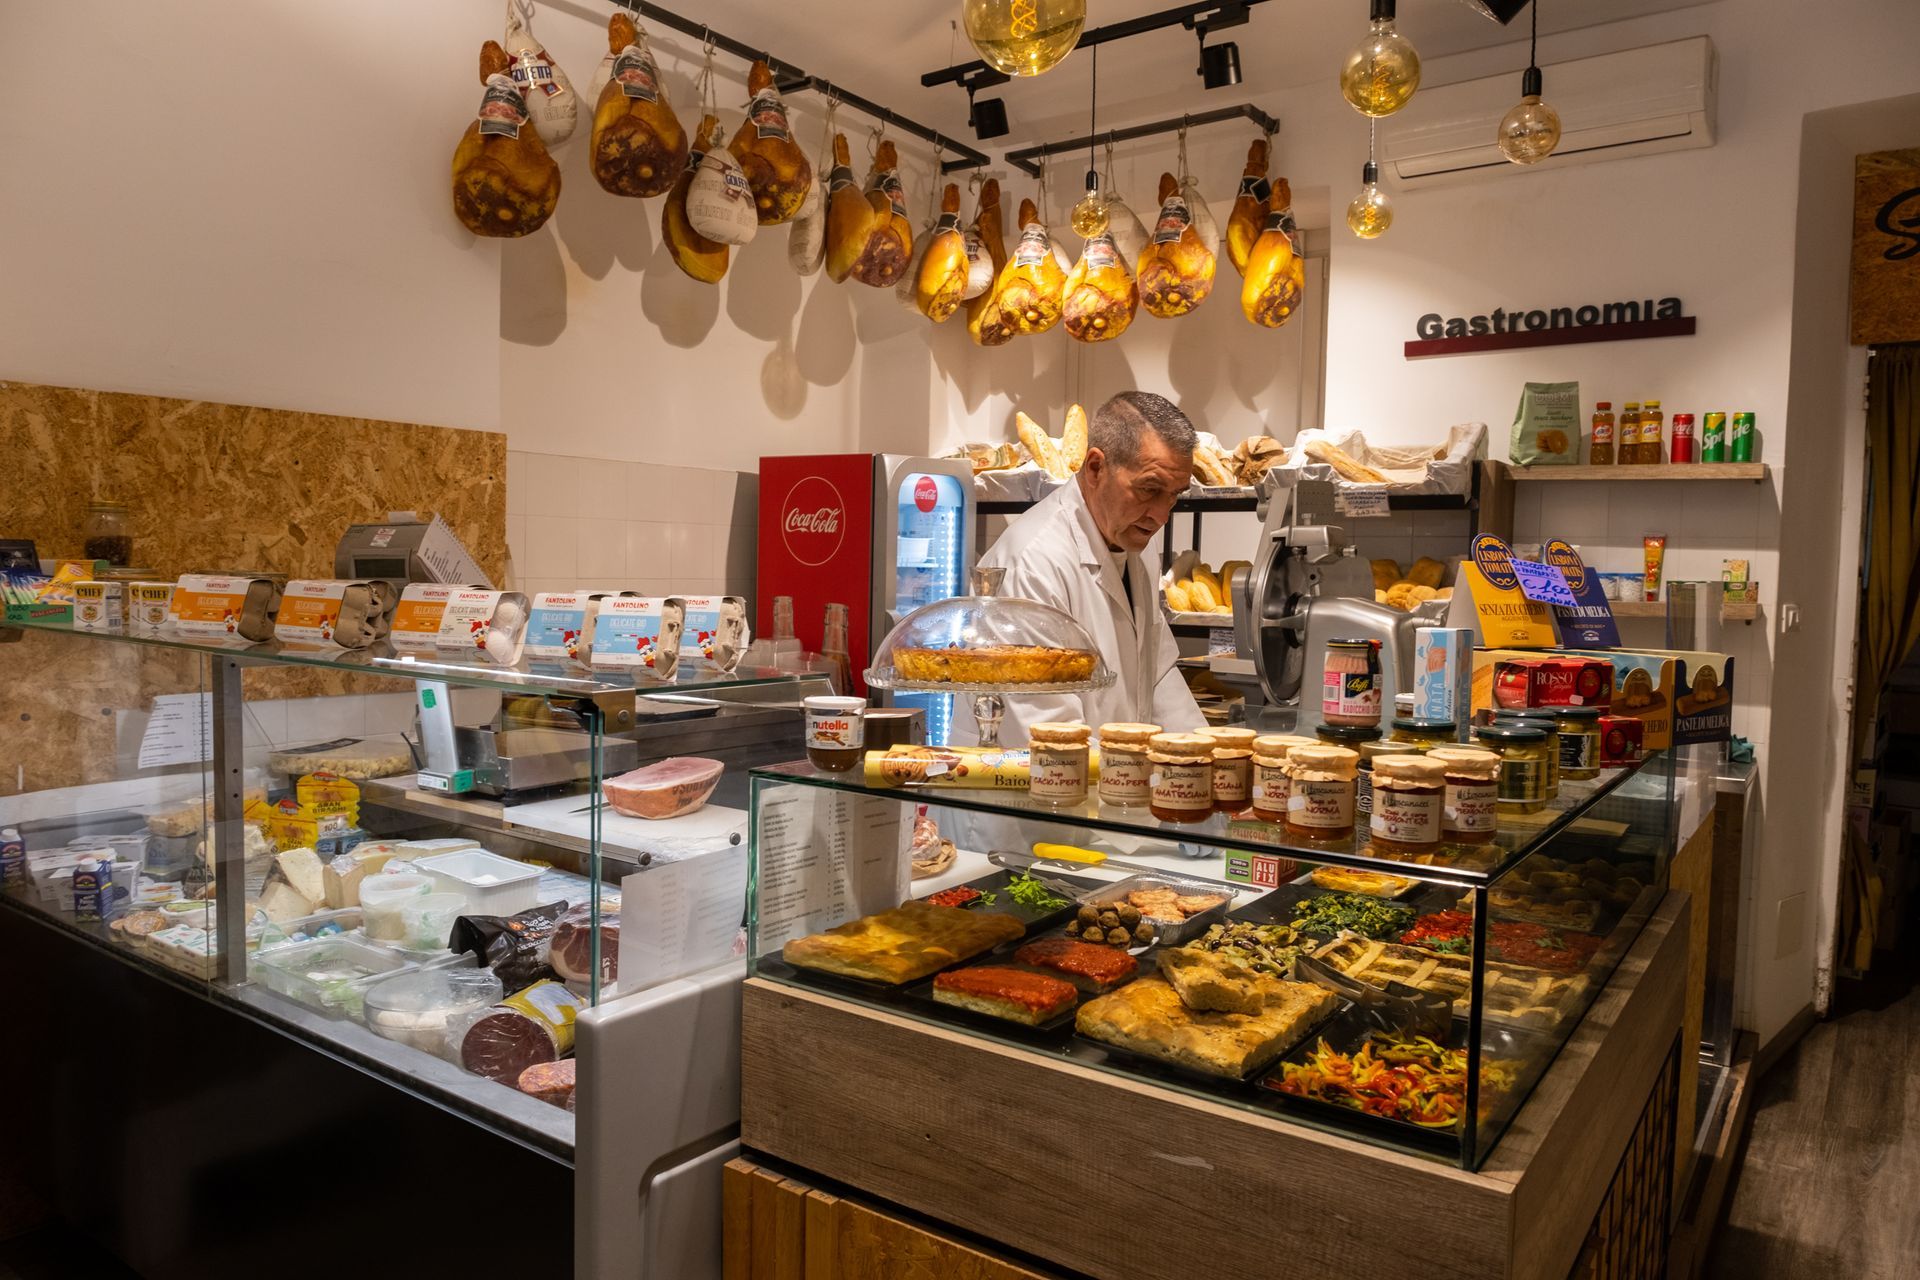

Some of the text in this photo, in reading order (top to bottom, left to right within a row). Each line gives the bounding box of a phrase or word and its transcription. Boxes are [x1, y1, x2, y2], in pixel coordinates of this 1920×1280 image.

[1416, 296, 1682, 341] Gastronomia
[785, 507, 841, 533] Coca-Cola
[1482, 562, 1513, 574] TOMATI
[76, 588, 102, 597] CHEF
[142, 589, 169, 599] CHEF
[422, 590, 449, 598] FANTOLINO
[458, 592, 490, 600] FANTOLINO
[545, 596, 577, 605] FANTOLINO
[612, 601, 650, 609] FANTOLINO
[1536, 671, 1573, 686] ROSSO
[1346, 678, 1371, 692] Biffi
[812, 720, 849, 730] nutella
[1256, 861, 1275, 875] ALU
[1255, 871, 1274, 884] FIX
